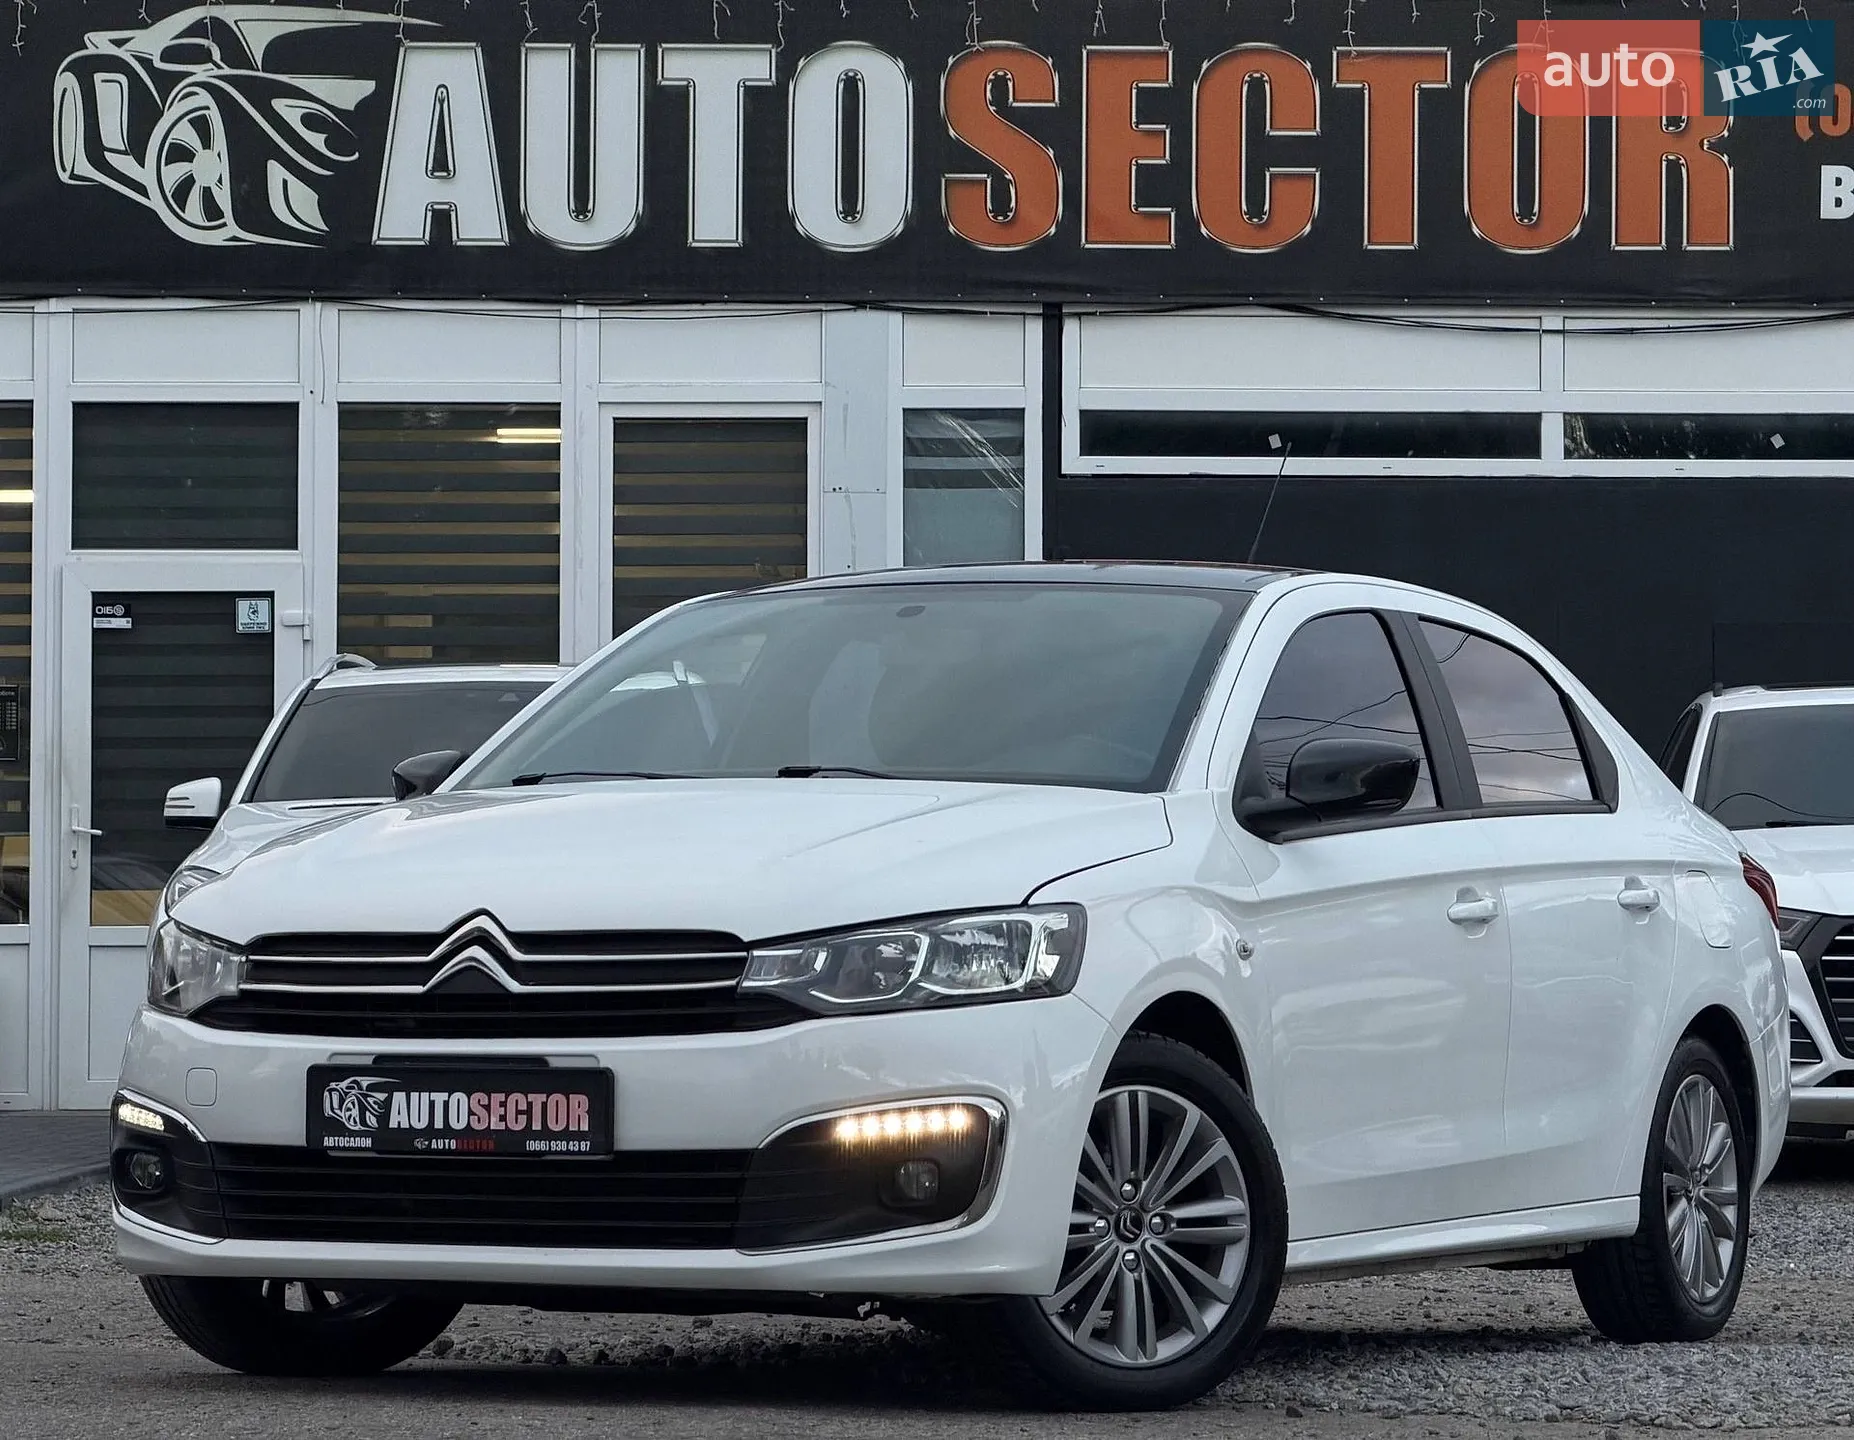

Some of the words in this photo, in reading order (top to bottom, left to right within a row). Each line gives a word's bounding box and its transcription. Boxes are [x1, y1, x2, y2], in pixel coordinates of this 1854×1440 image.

[388, 1091, 590, 1132] AUTOSECTOR
[323, 1136, 372, 1148] АВТОСАЛОН
[525, 1140, 549, 1151] (066)
[550, 1140, 567, 1151] 930
[568, 1140, 579, 1152] 43
[580, 1140, 591, 1152] 87
